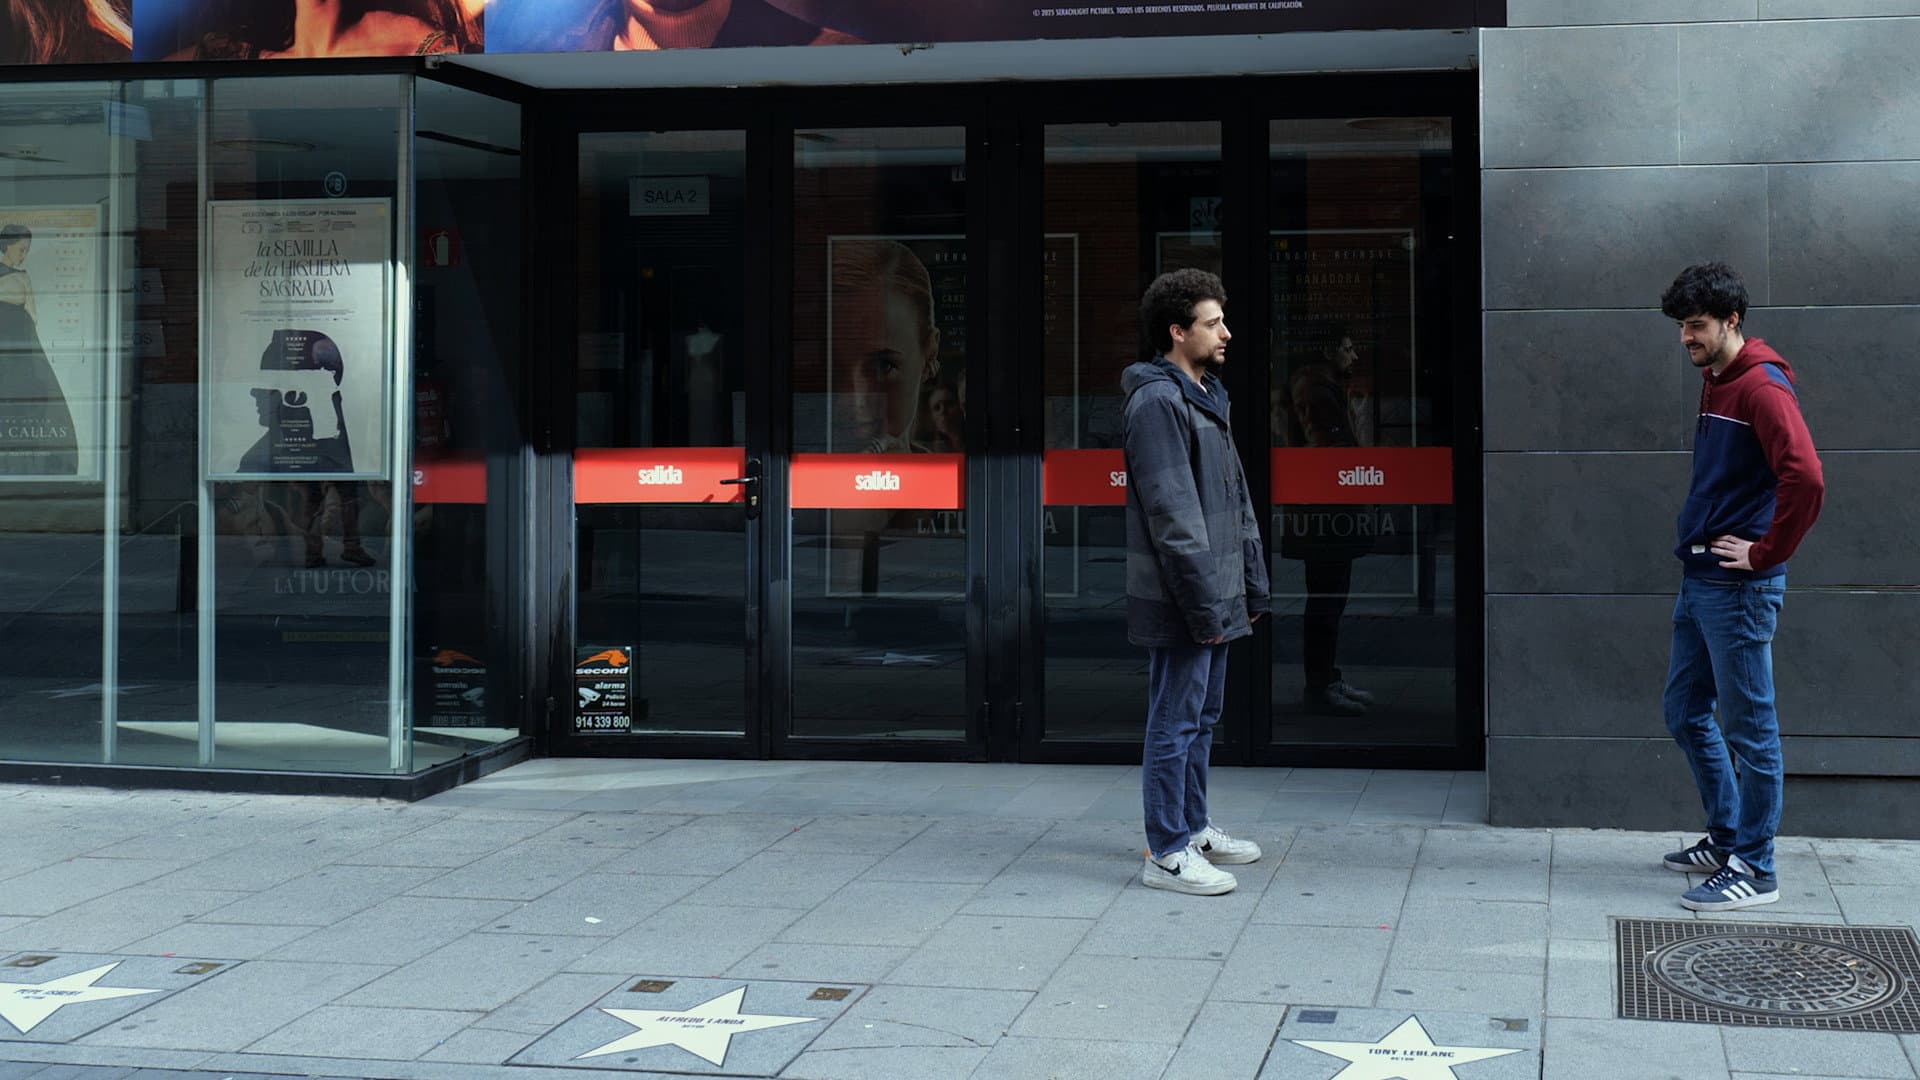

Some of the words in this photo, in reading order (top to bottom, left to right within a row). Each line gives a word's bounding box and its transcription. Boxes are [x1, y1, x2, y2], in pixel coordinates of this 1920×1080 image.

[1116, 7, 1133, 15] TODOS
[1134, 6, 1145, 14] LOS
[1145, 5, 1171, 13] DERECHOS
[1173, 4, 1205, 13] RESERVADOS.
[1231, 2, 1258, 10] PENDIENTE
[645, 189, 684, 204] SALA
[687, 189, 697, 203] 2
[256, 240, 271, 257] la
[273, 239, 338, 257] SEMILLA
[244, 260, 262, 278] de
[263, 260, 279, 278] la
[281, 258, 351, 277] HIGUERA
[259, 279, 334, 297] SAGRADA
[8, 426, 67, 440] CALLAS
[638, 464, 683, 485] salida
[855, 470, 900, 491] salida
[1337, 465, 1385, 487] salida
[575, 666, 629, 675] second
[594, 681, 626, 690] alarma
[575, 716, 593, 728] 914
[594, 716, 611, 728] 339
[613, 716, 630, 728] 800
[706, 1017, 745, 1025] LANDA
[1403, 1050, 1455, 1058] LEBLANC
